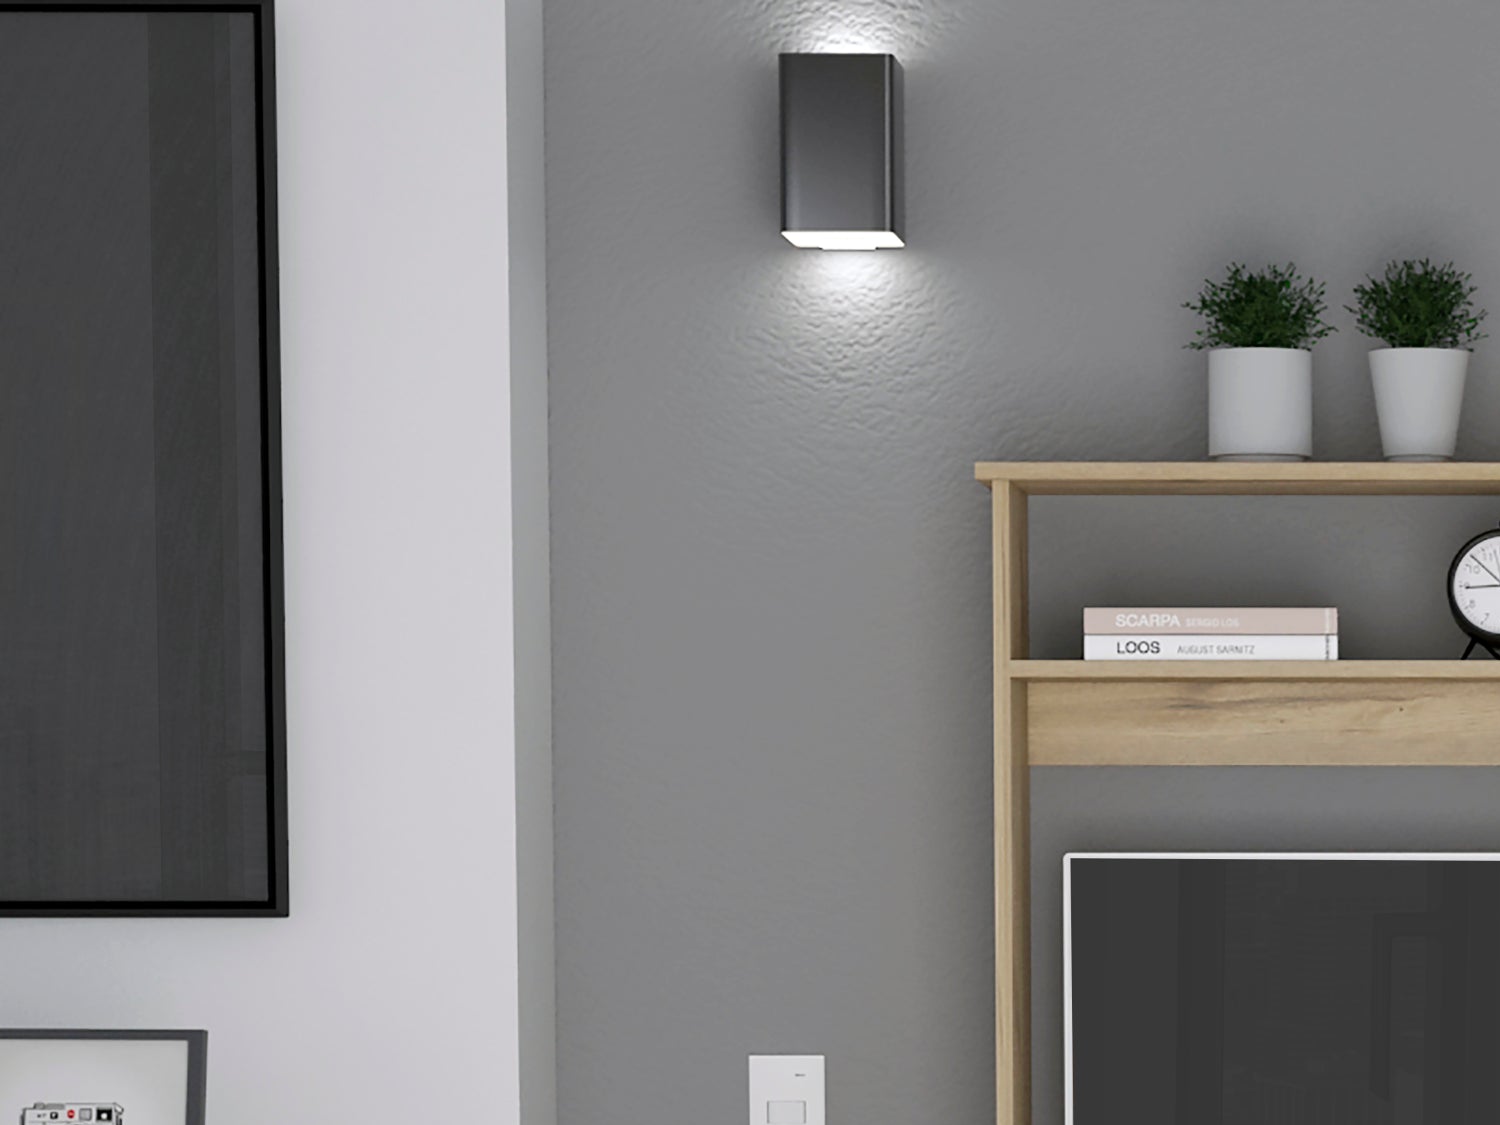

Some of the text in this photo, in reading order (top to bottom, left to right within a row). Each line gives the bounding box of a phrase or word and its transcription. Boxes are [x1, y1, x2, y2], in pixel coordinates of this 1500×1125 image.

[1115, 613, 1181, 628] SCARPA
[1117, 641, 1256, 655] LOOS AUGUST SARNITZ
